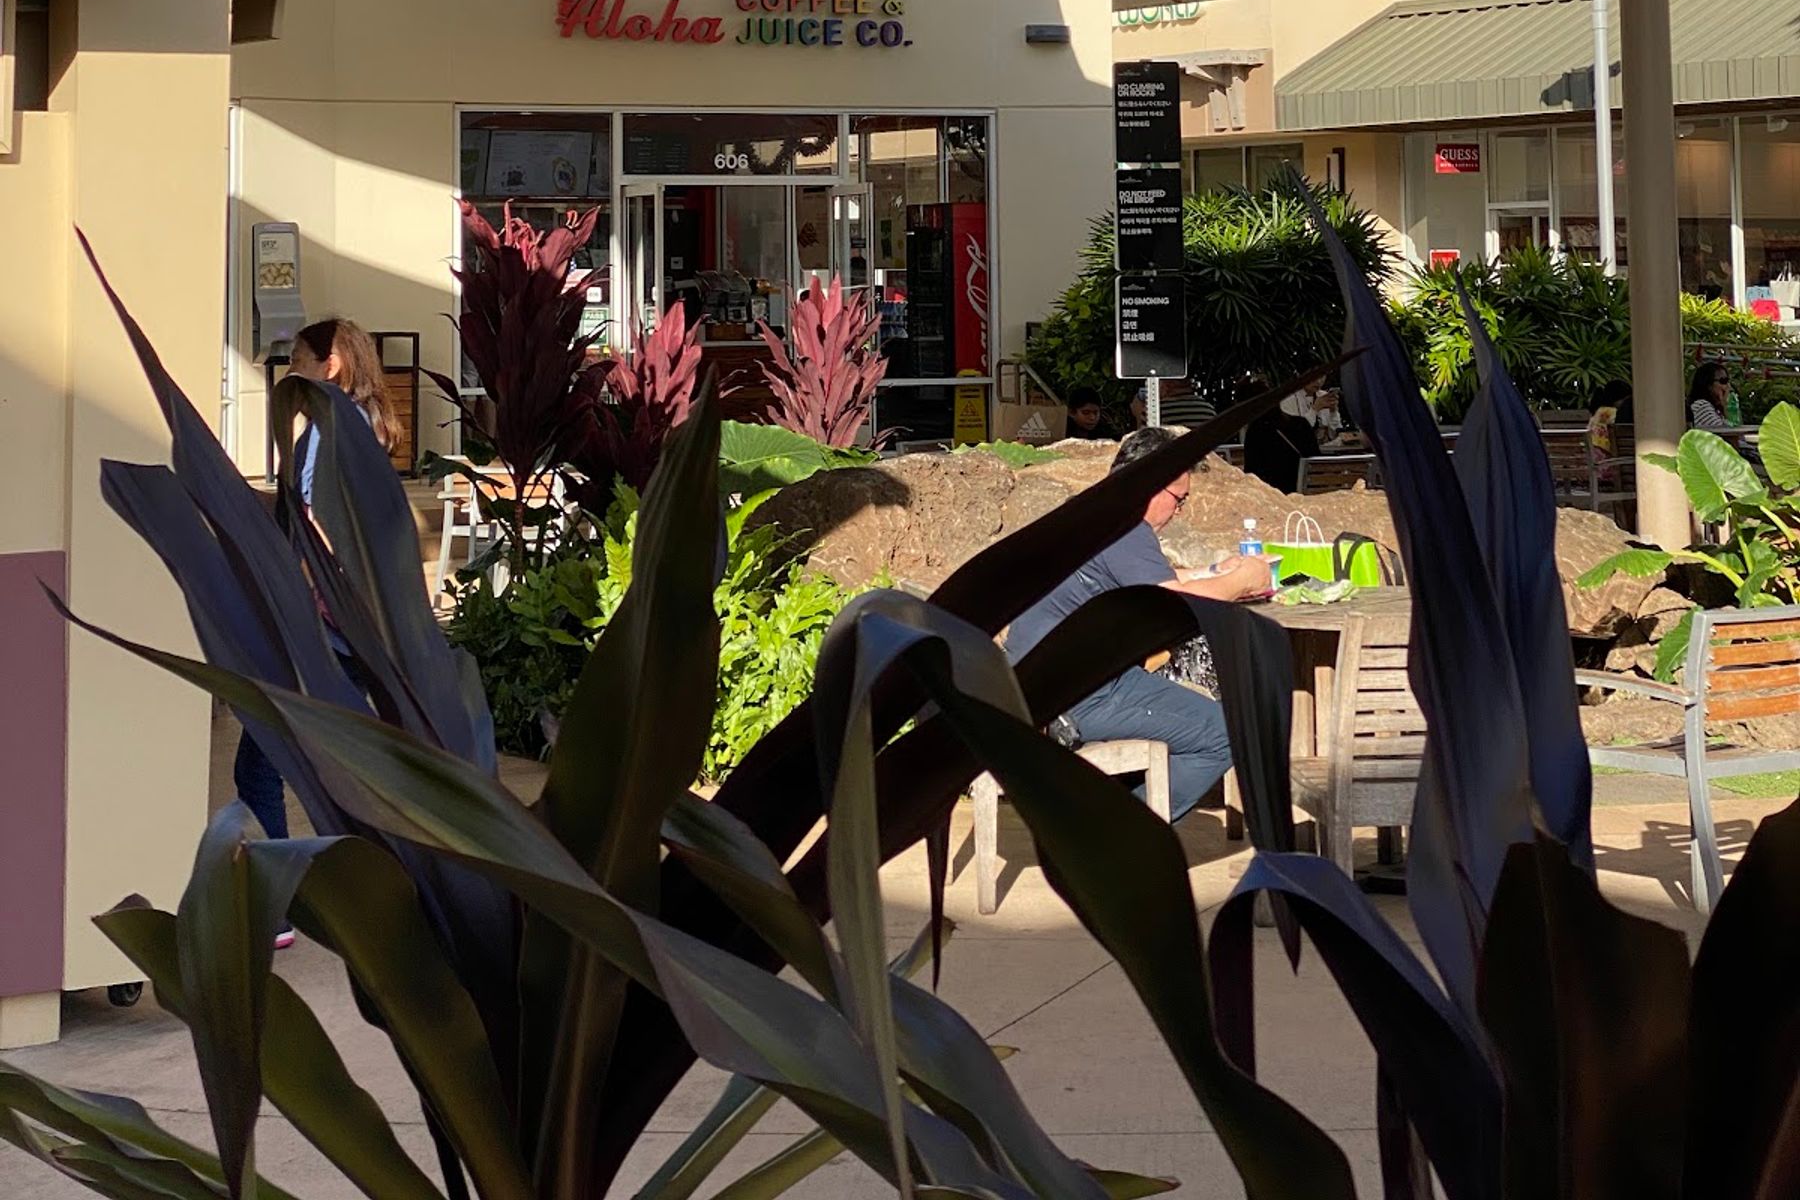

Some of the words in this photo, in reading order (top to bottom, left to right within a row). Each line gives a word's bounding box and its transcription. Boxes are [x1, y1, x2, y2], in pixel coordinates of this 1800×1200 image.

[736, 17, 844, 46] JUICE
[856, 19, 914, 47] CO.
[714, 153, 749, 169] 606
[1440, 148, 1479, 161] GUESS
[1122, 297, 1134, 306] NO
[1134, 296, 1170, 306] SMOKING
